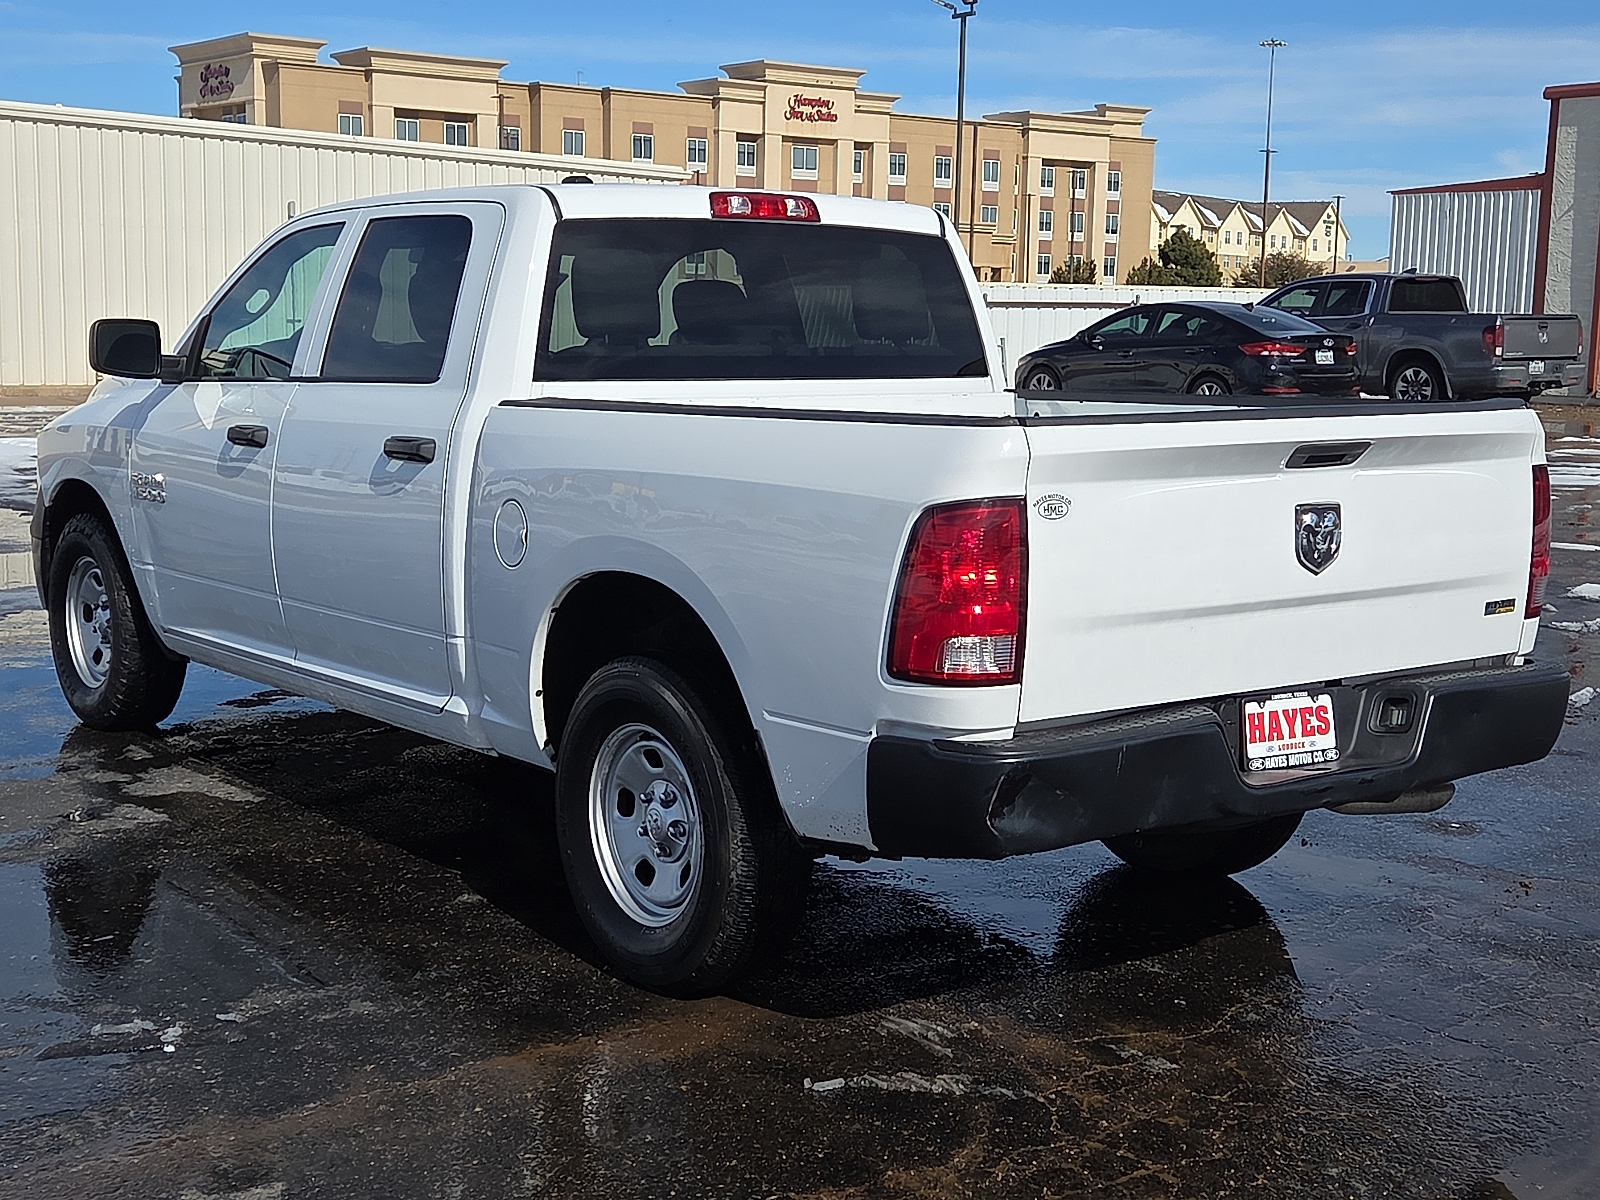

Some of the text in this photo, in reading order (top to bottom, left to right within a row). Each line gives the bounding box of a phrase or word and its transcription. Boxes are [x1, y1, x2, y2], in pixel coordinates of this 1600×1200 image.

[788, 94, 835, 110] Hampton
[784, 107, 806, 122] Inn
[813, 109, 838, 122] Suites
[1043, 503, 1064, 516] HMC
[1247, 705, 1331, 744] HAYES
[1265, 755, 1288, 769] HAYES
[1288, 751, 1313, 766] MOTOR
